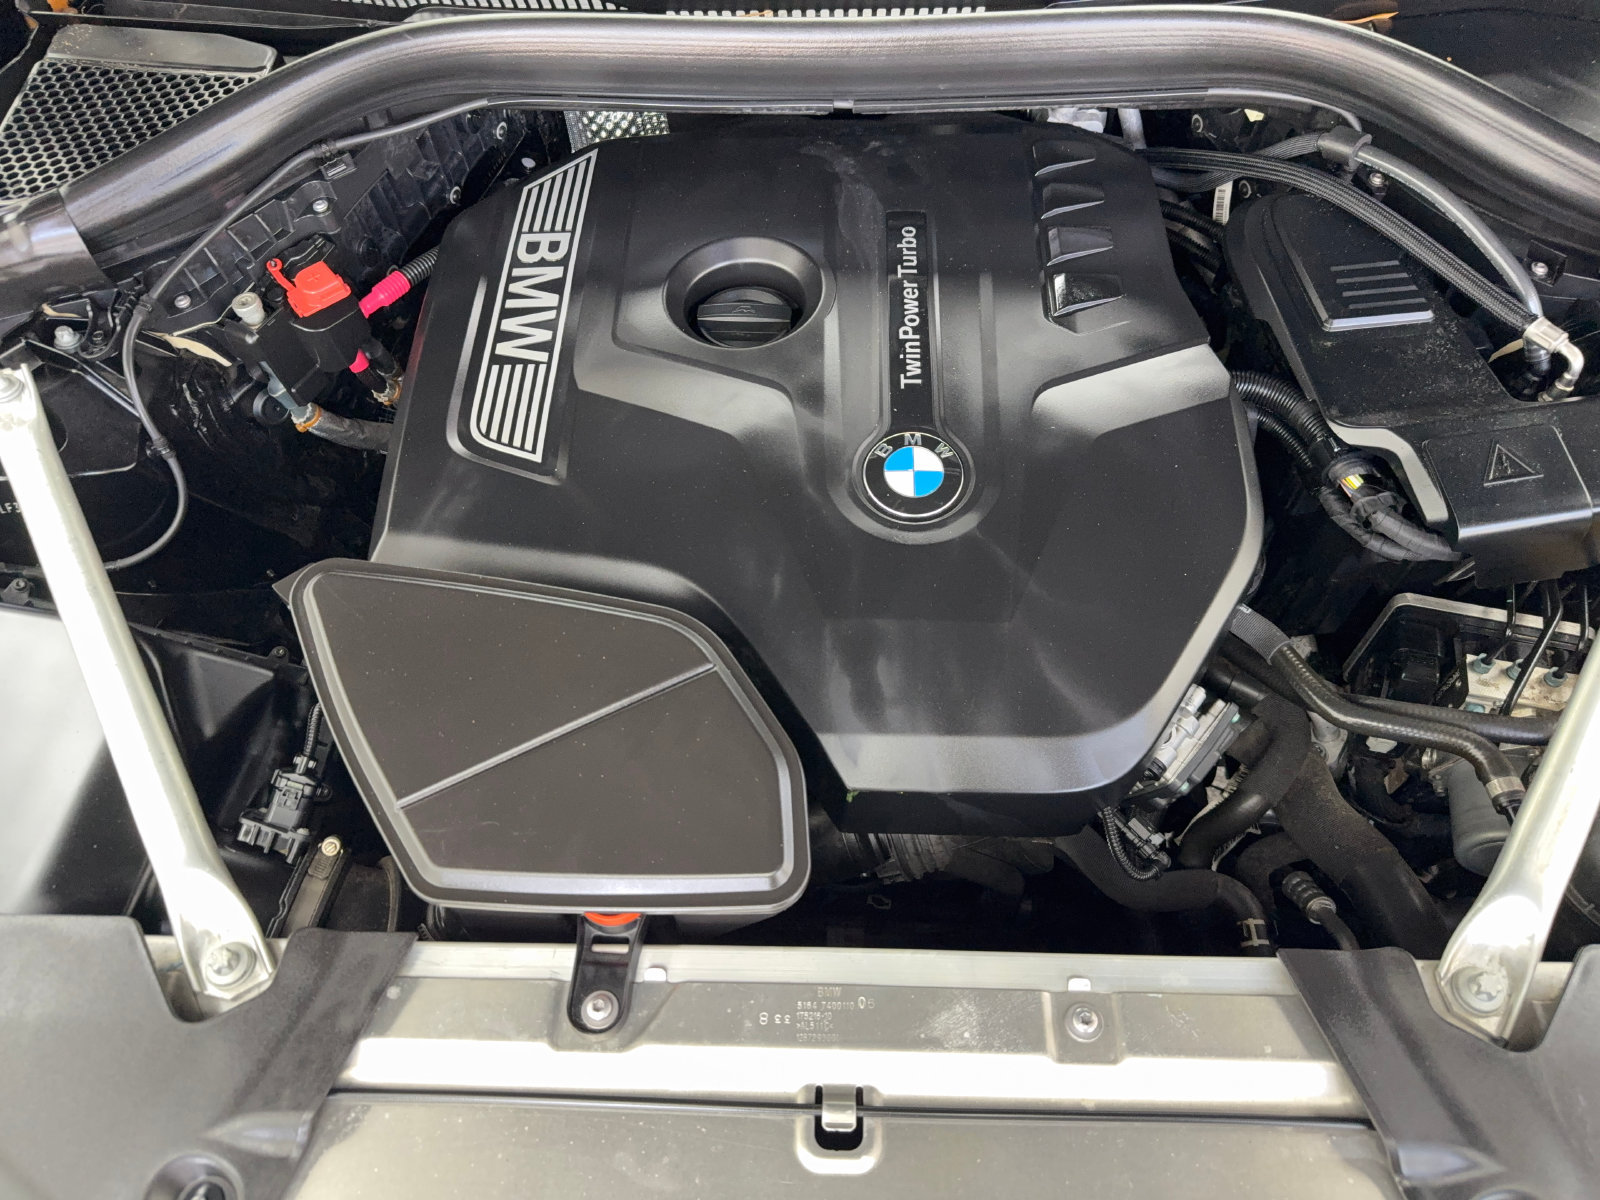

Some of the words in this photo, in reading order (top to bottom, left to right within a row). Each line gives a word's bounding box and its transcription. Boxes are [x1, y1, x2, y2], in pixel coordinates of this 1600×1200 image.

[897, 225, 918, 278] Turbo
[494, 231, 572, 363] BMW
[898, 281, 922, 389] TwinPower
[874, 433, 954, 460] BMW
